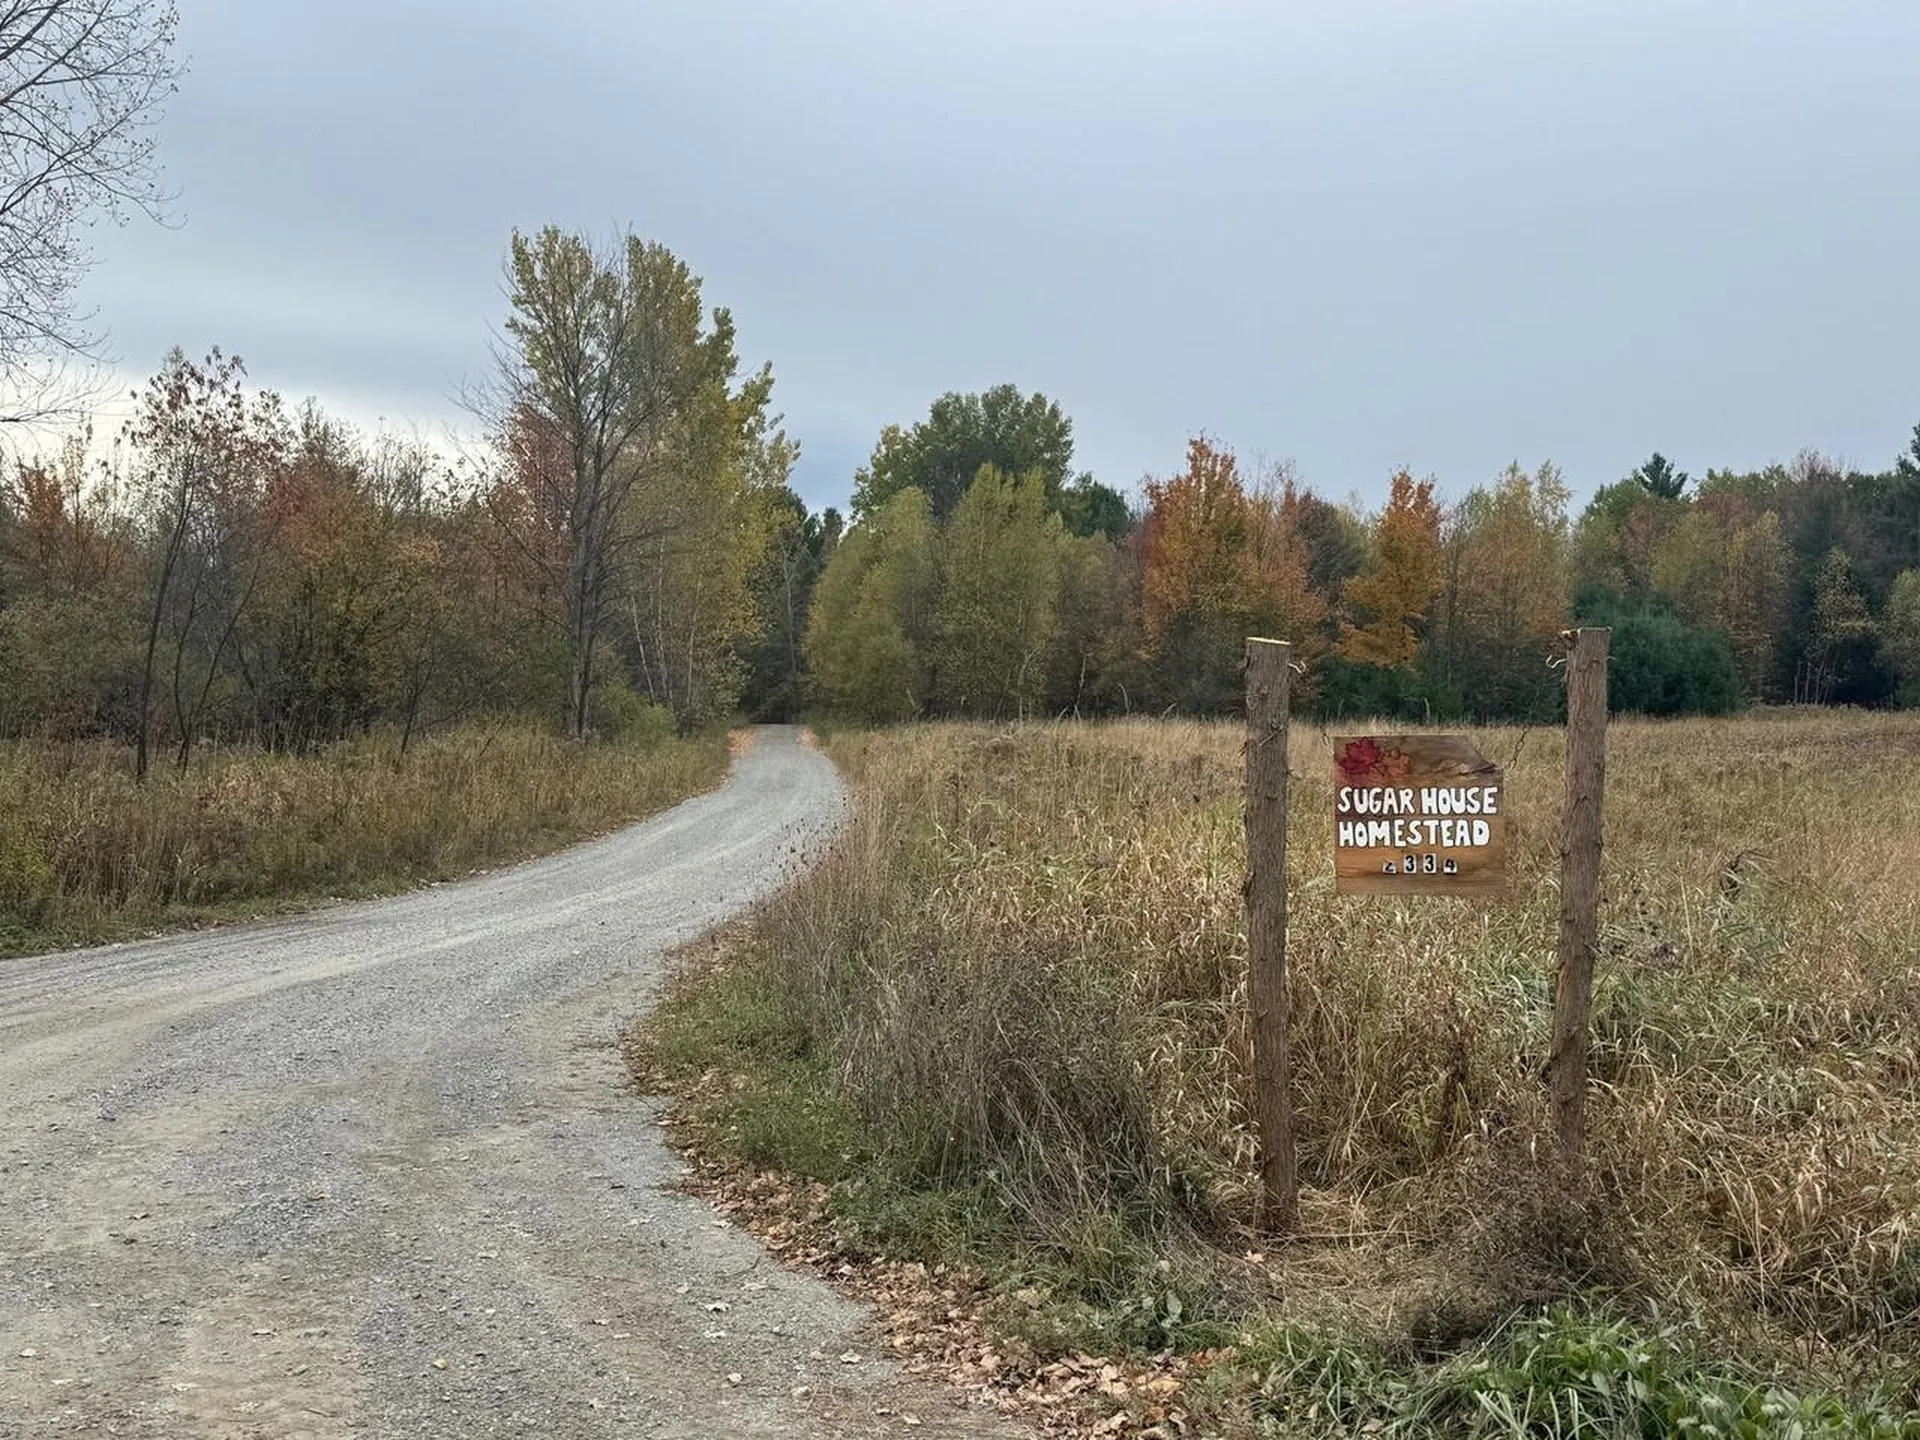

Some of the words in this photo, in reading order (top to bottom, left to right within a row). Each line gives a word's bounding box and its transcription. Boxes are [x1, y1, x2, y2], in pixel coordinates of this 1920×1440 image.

[1338, 786, 1415, 815] SUGAR
[1420, 786, 1498, 815] HOUSE
[1338, 819, 1491, 848] HOMESTEAD
